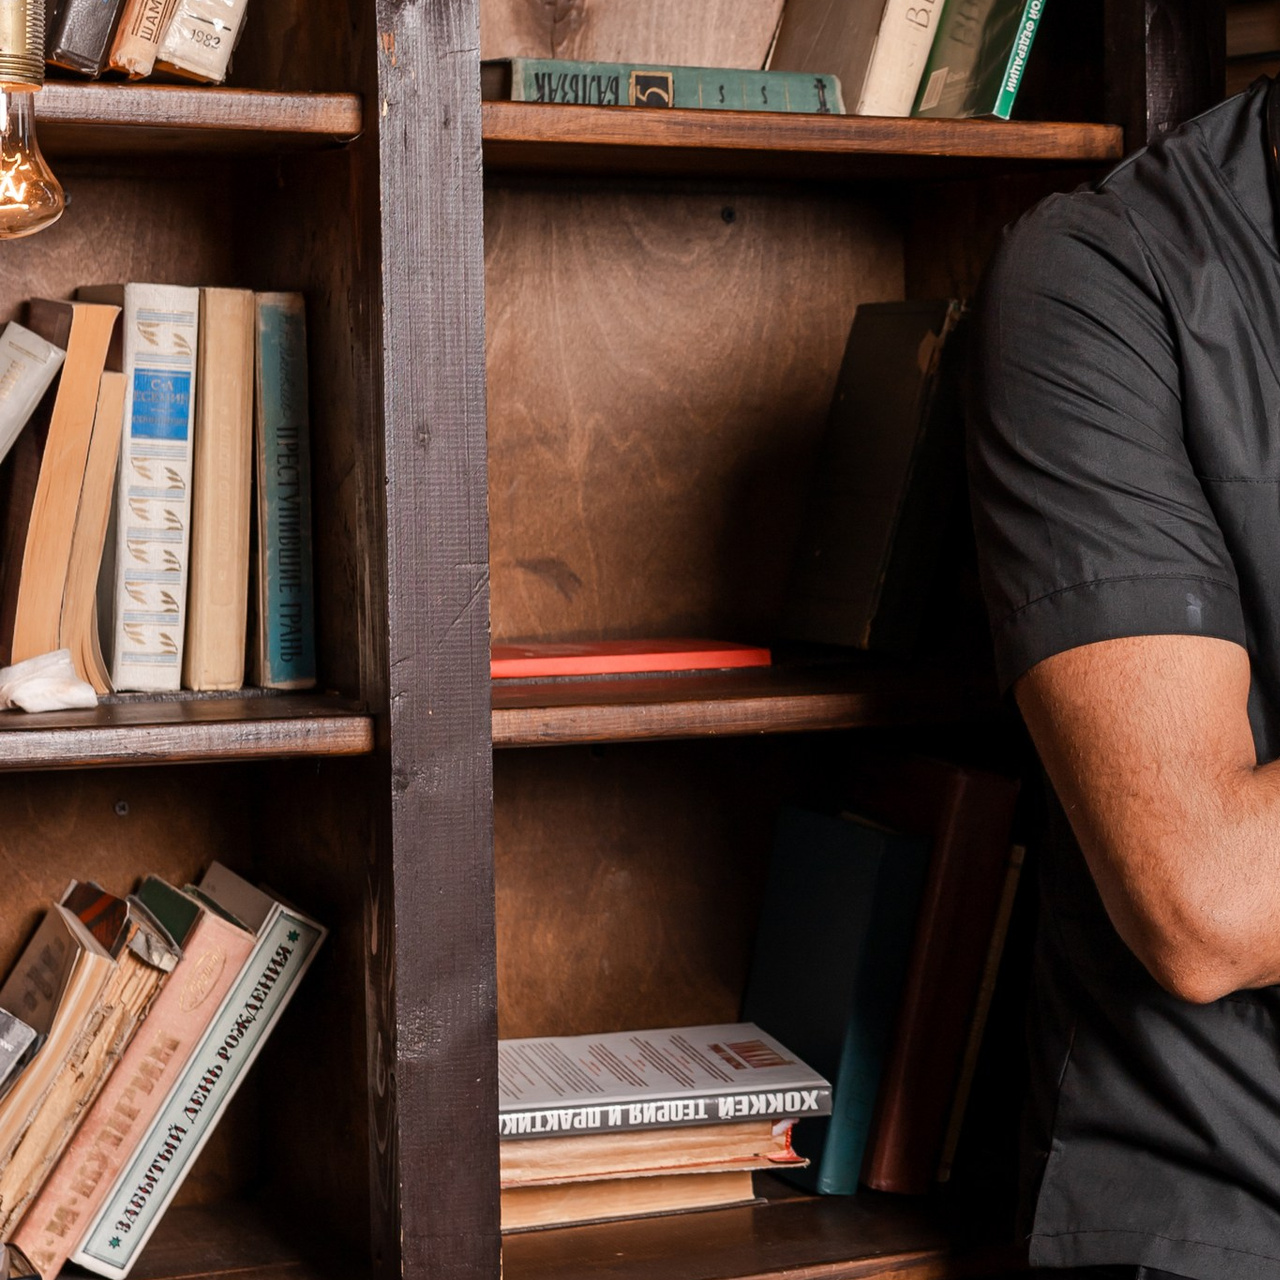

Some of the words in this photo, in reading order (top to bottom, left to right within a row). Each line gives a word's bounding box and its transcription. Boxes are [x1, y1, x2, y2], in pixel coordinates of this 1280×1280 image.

[188, 27, 221, 50] 1982
[1006, 17, 1037, 93] ФЕДЕРАЦИИ
[533, 71, 620, 107] БАЛЬЗАК
[275, 426, 299, 594] ПРЕСТУПИВШИЕ
[280, 600, 304, 663] ГРАНЬ
[114, 1124, 189, 1234] ЗАБЫТЫЙ
[185, 1063, 225, 1125] ДЕНЬ
[218, 944, 295, 1064] РОЖДЕНИЯ
[718, 1089, 819, 1119] ХОККЕЙ
[608, 1103, 622, 1128] И
[628, 1097, 708, 1126] ТЕОРИЯ
